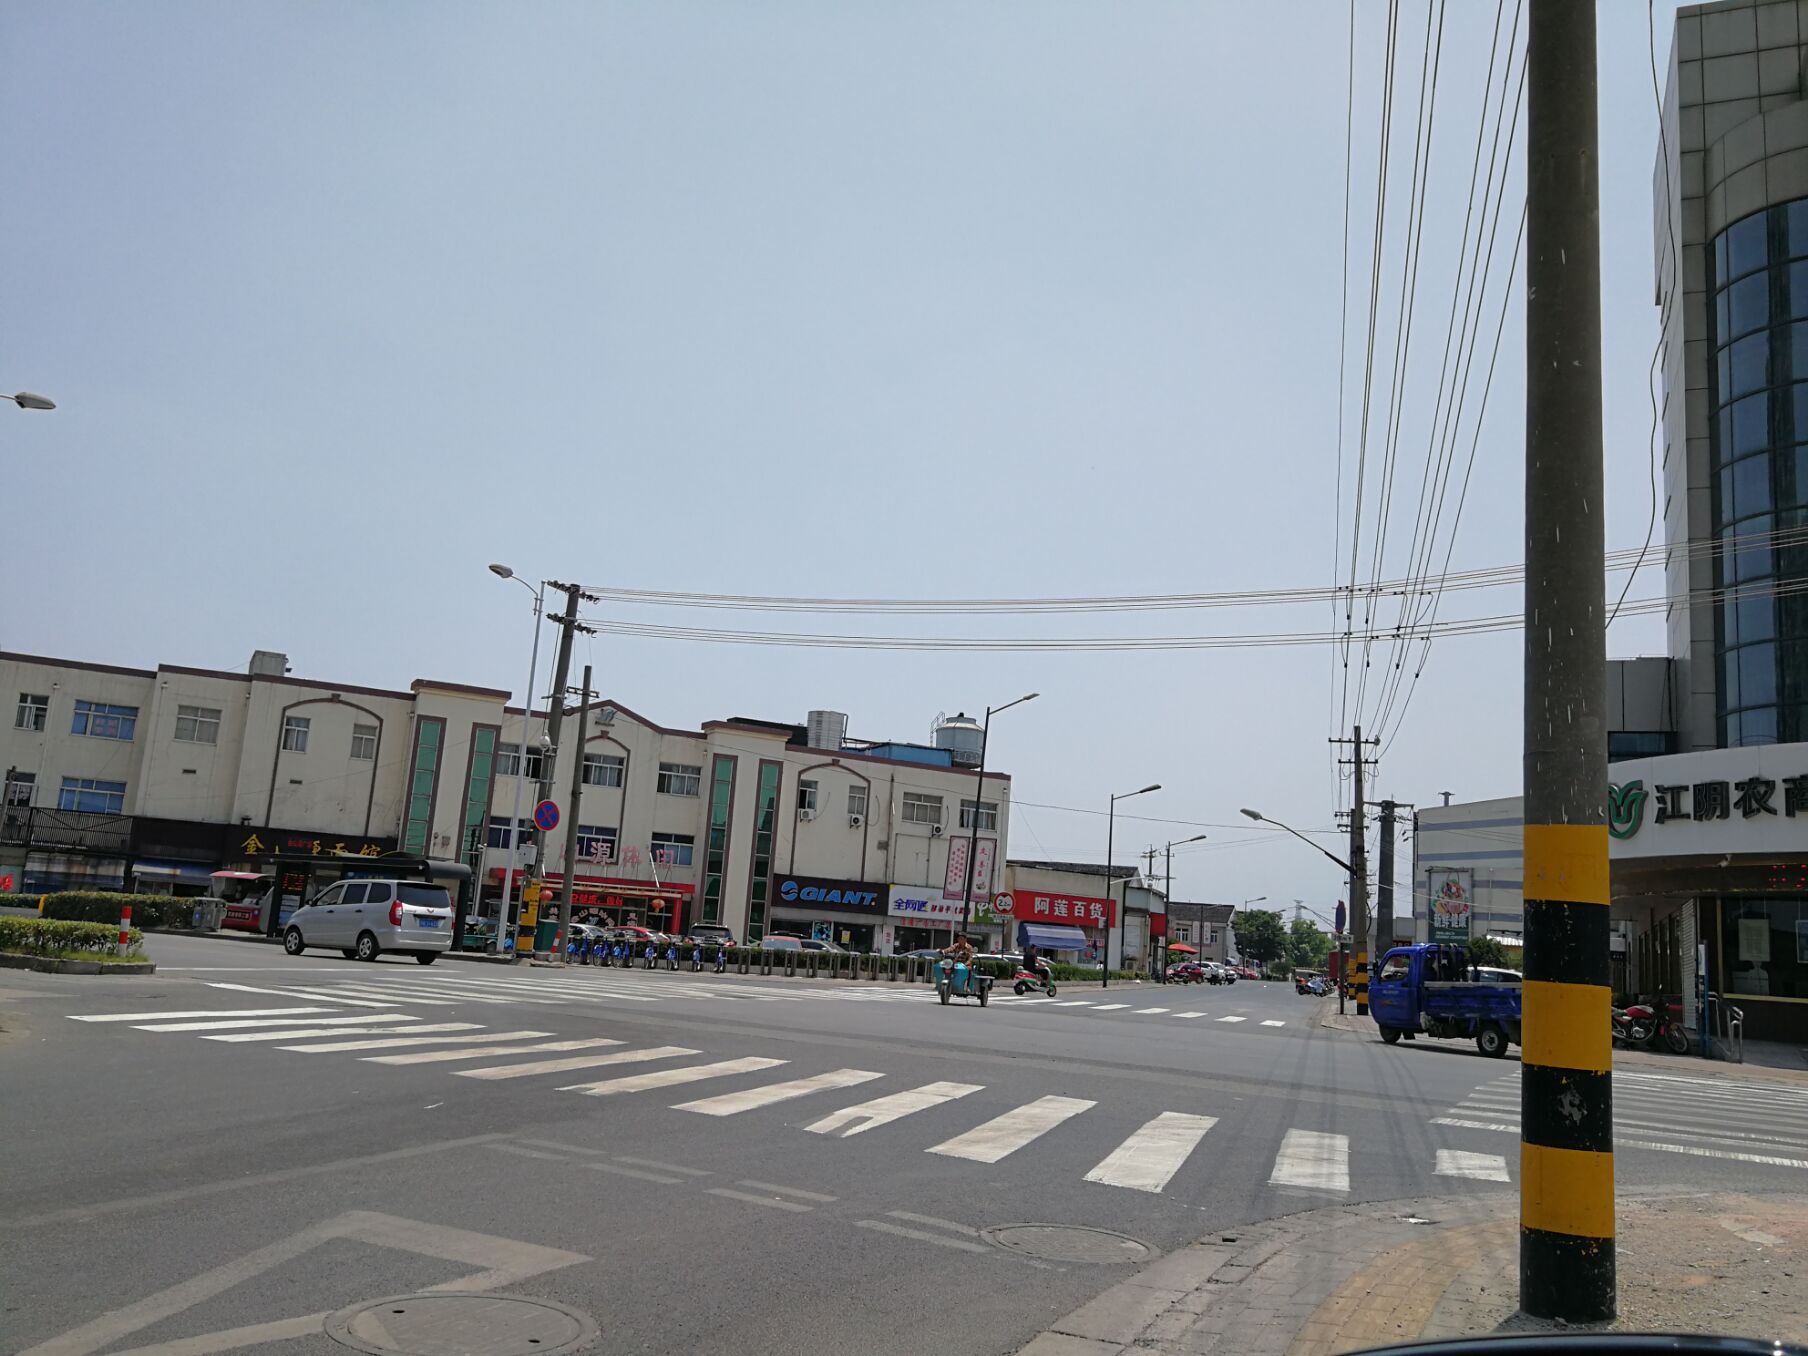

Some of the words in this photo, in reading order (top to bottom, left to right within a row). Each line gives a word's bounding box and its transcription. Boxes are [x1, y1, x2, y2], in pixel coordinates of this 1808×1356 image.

[799, 886, 878, 906] GIANT
[1033, 896, 1105, 920] 阿莲百货
